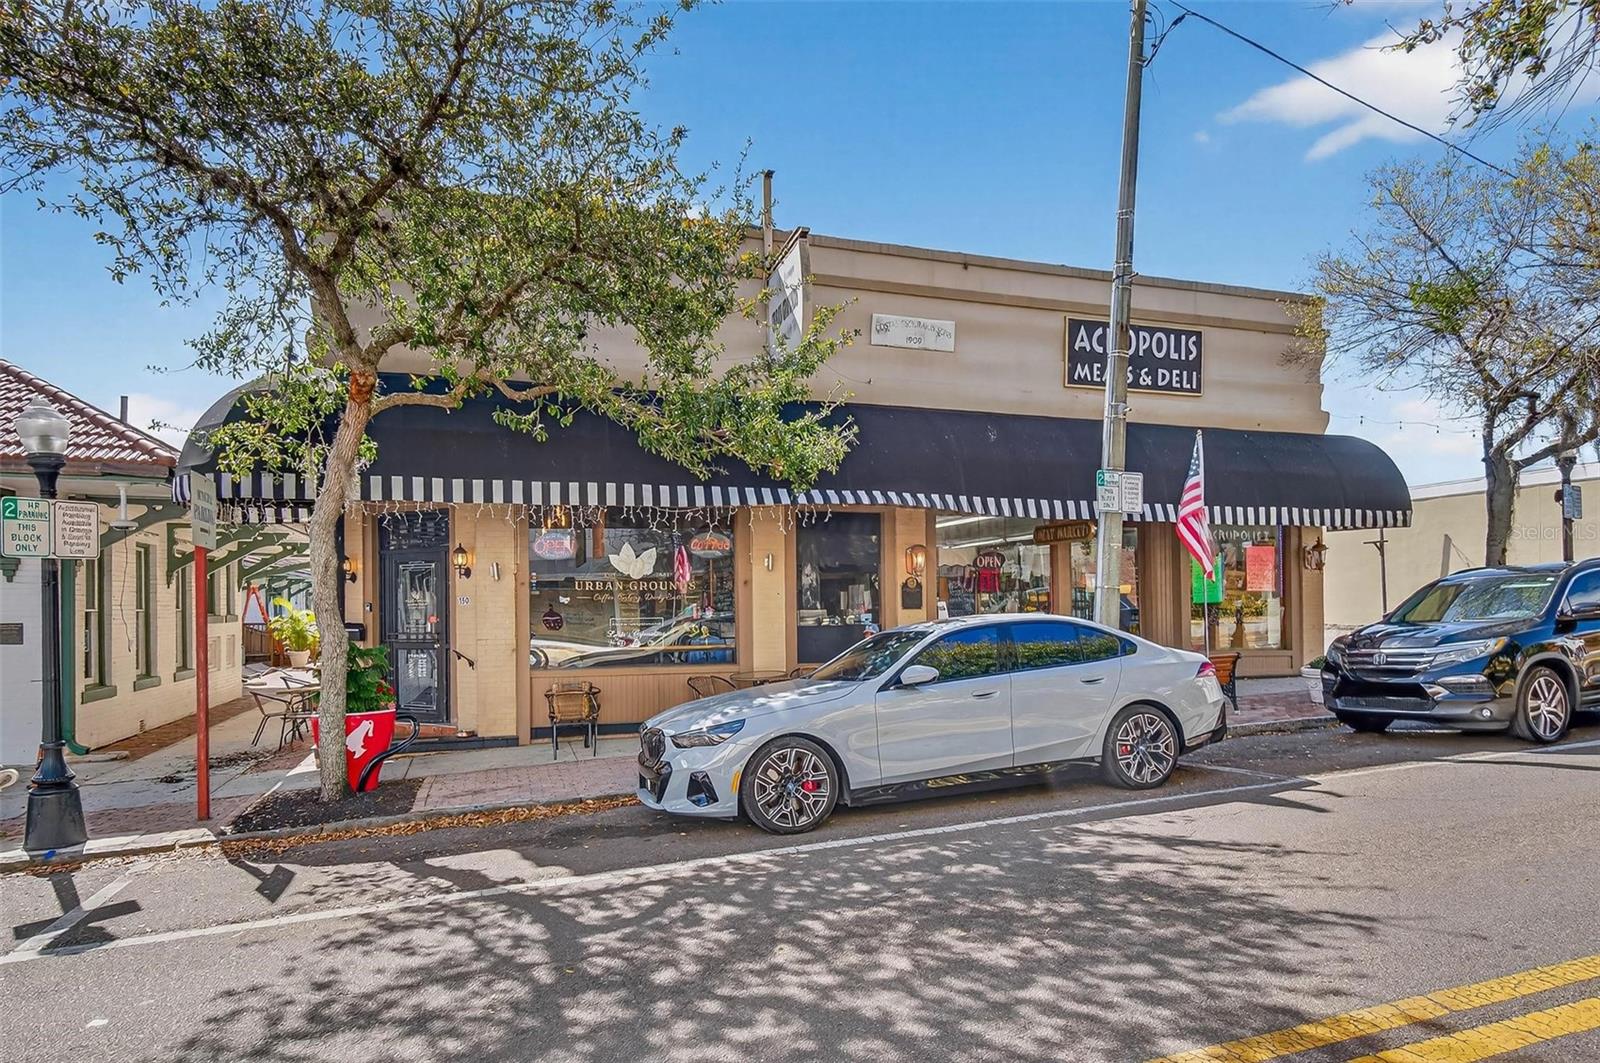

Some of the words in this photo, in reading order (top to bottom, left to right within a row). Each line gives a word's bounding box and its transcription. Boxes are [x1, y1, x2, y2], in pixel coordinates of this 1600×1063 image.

[906, 336, 922, 344] 1909
[1140, 367, 1152, 386] &
[1158, 368, 1197, 389] DELI
[4, 502, 16, 517] 2
[18, 523, 36, 531] THIS
[11, 533, 42, 542] BLOCK
[15, 543, 38, 552] ONLY
[976, 555, 1001, 568] OPEN
[575, 580, 623, 591] URBAN
